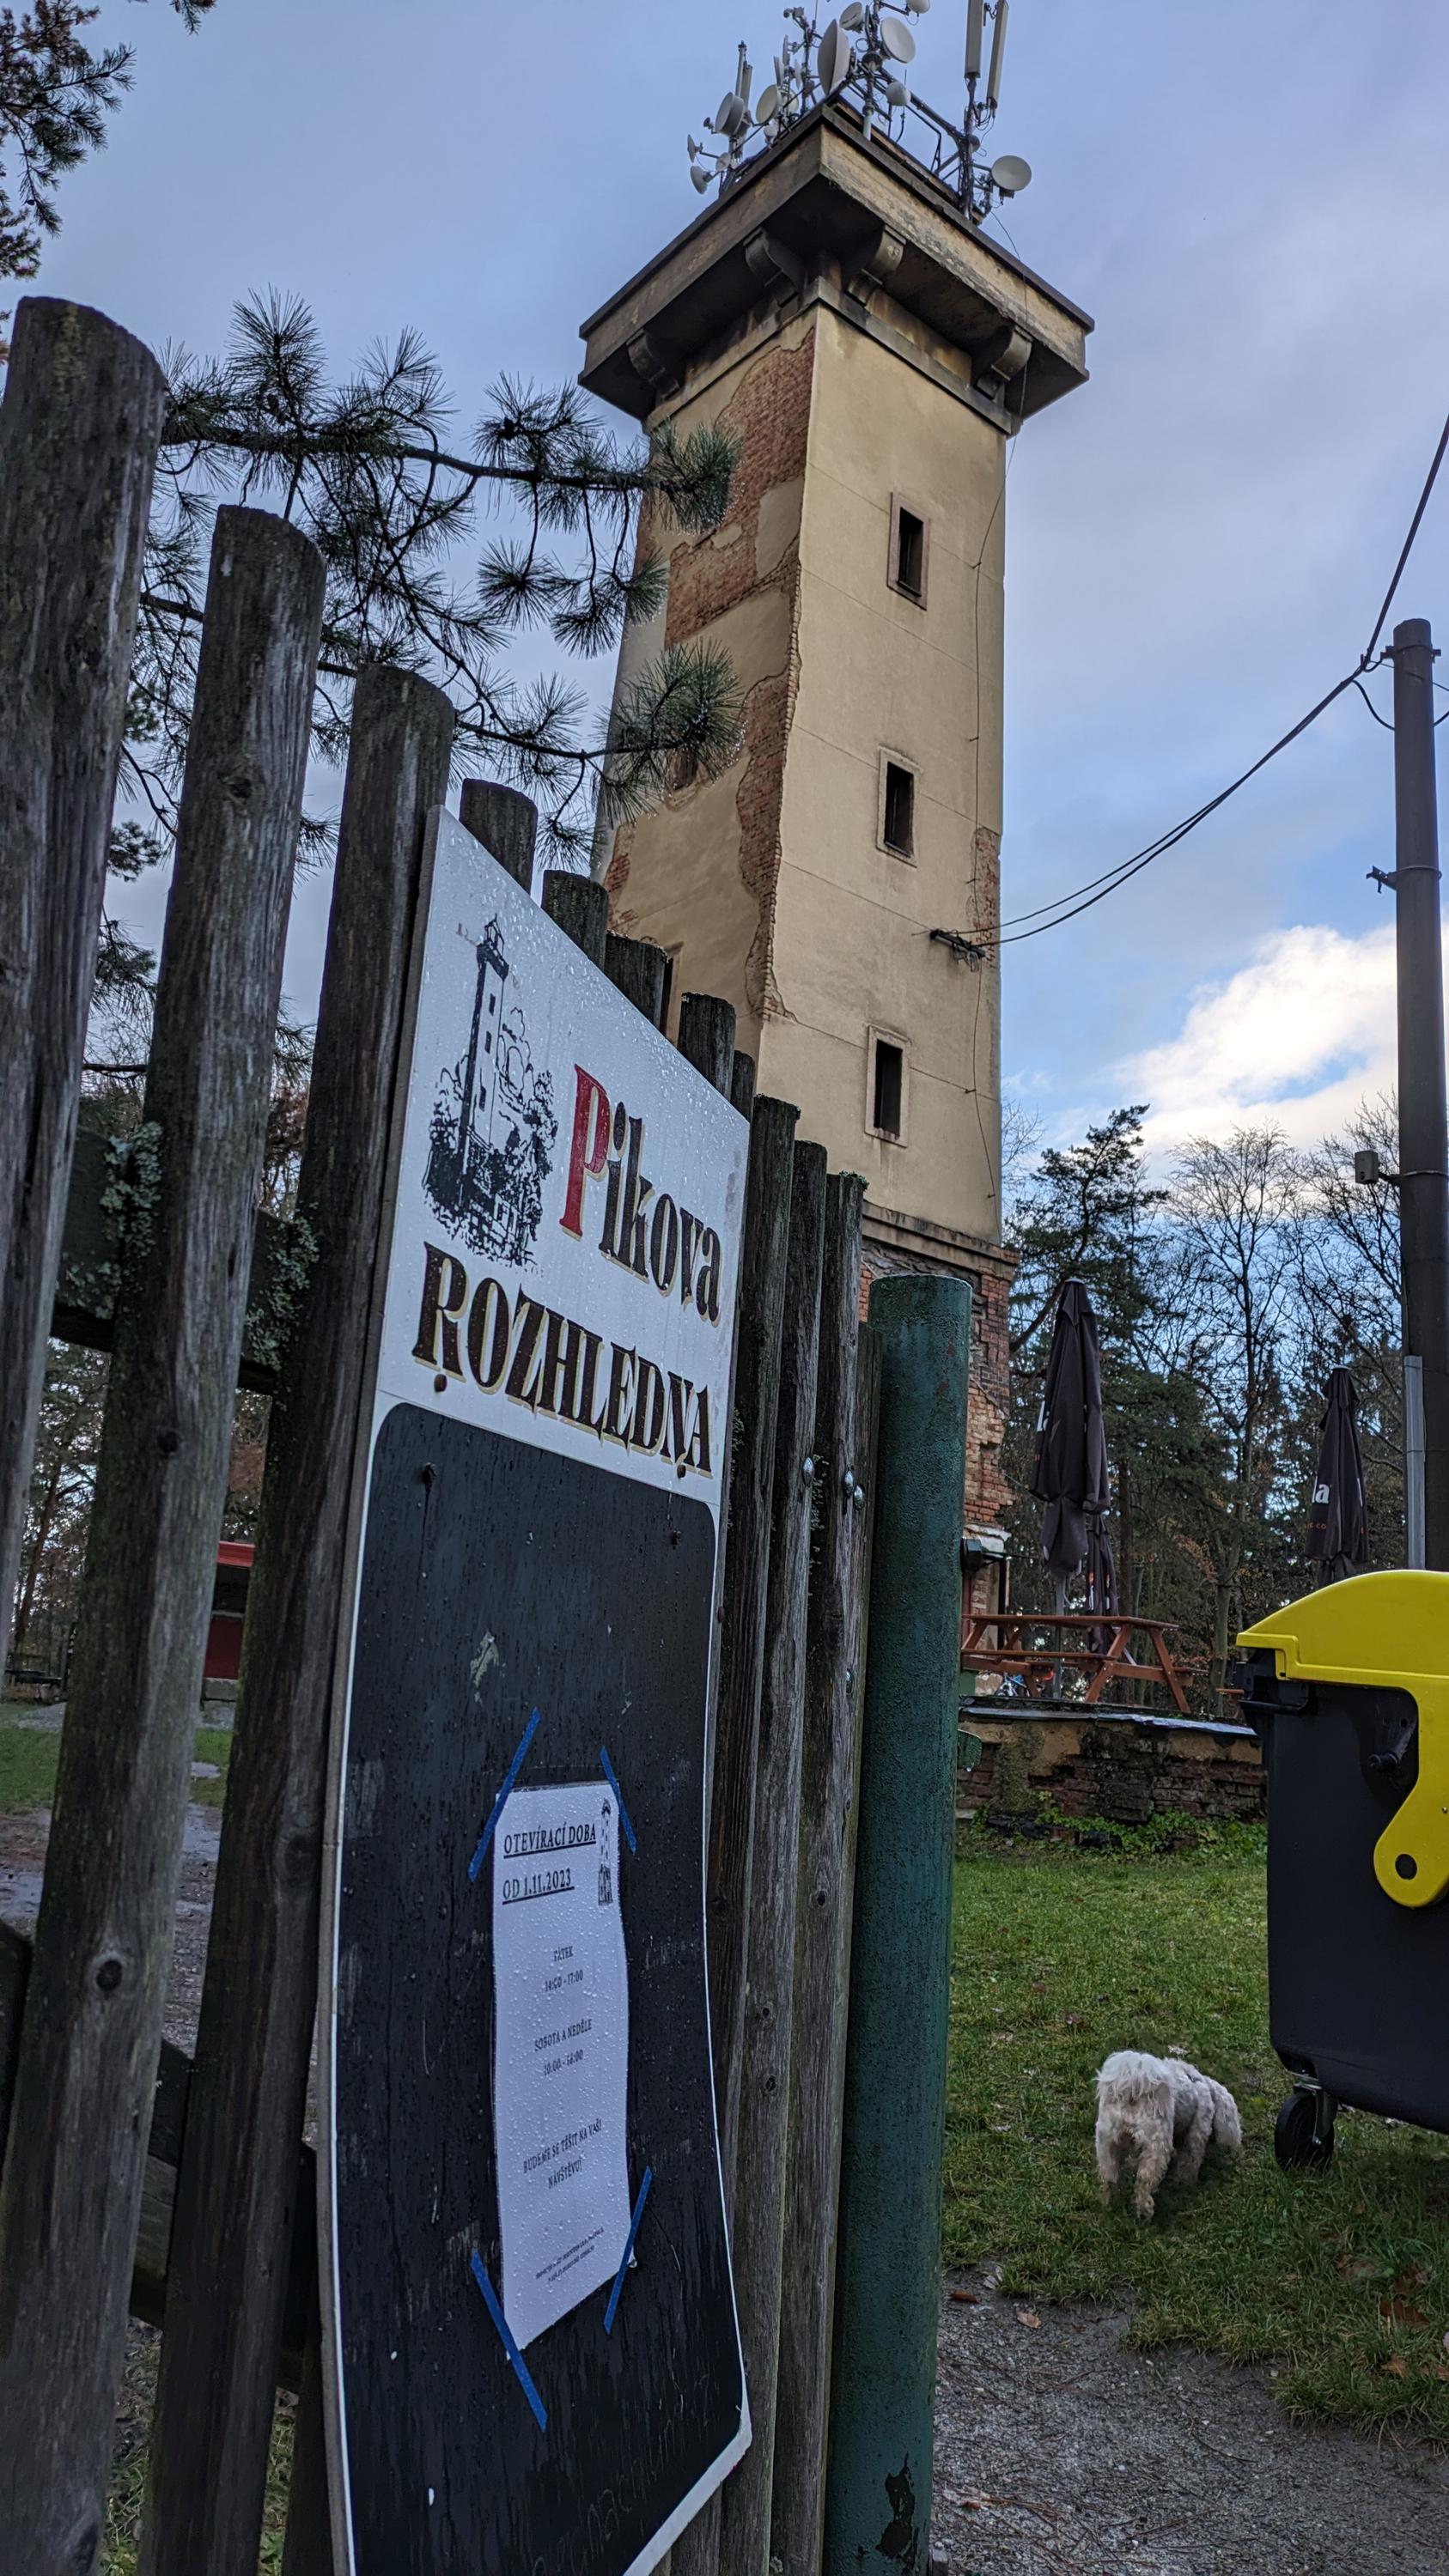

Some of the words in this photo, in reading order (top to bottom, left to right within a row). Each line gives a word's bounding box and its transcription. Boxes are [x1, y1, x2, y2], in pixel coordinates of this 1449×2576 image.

[559, 1064, 722, 1327] Pikova
[412, 1242, 714, 1478] ROZHLEDNA
[503, 1821, 566, 1855] OTEVÍRACÍ
[568, 1823, 596, 1844] DOBA
[502, 1878, 520, 1900] OD
[524, 1868, 571, 1896] 1.11.2023
[553, 1945, 574, 1962] PÁTEK
[567, 1969, 583, 1985] 17:00
[534, 2031, 560, 2051] SOBOTA
[562, 2029, 567, 2041] A
[567, 2019, 593, 2038] NEDĚLE
[523, 2147, 551, 2174] BUDEME
[551, 2142, 560, 2158] SE
[560, 2133, 578, 2152] TĚŠIT
[579, 2129, 588, 2142] NA
